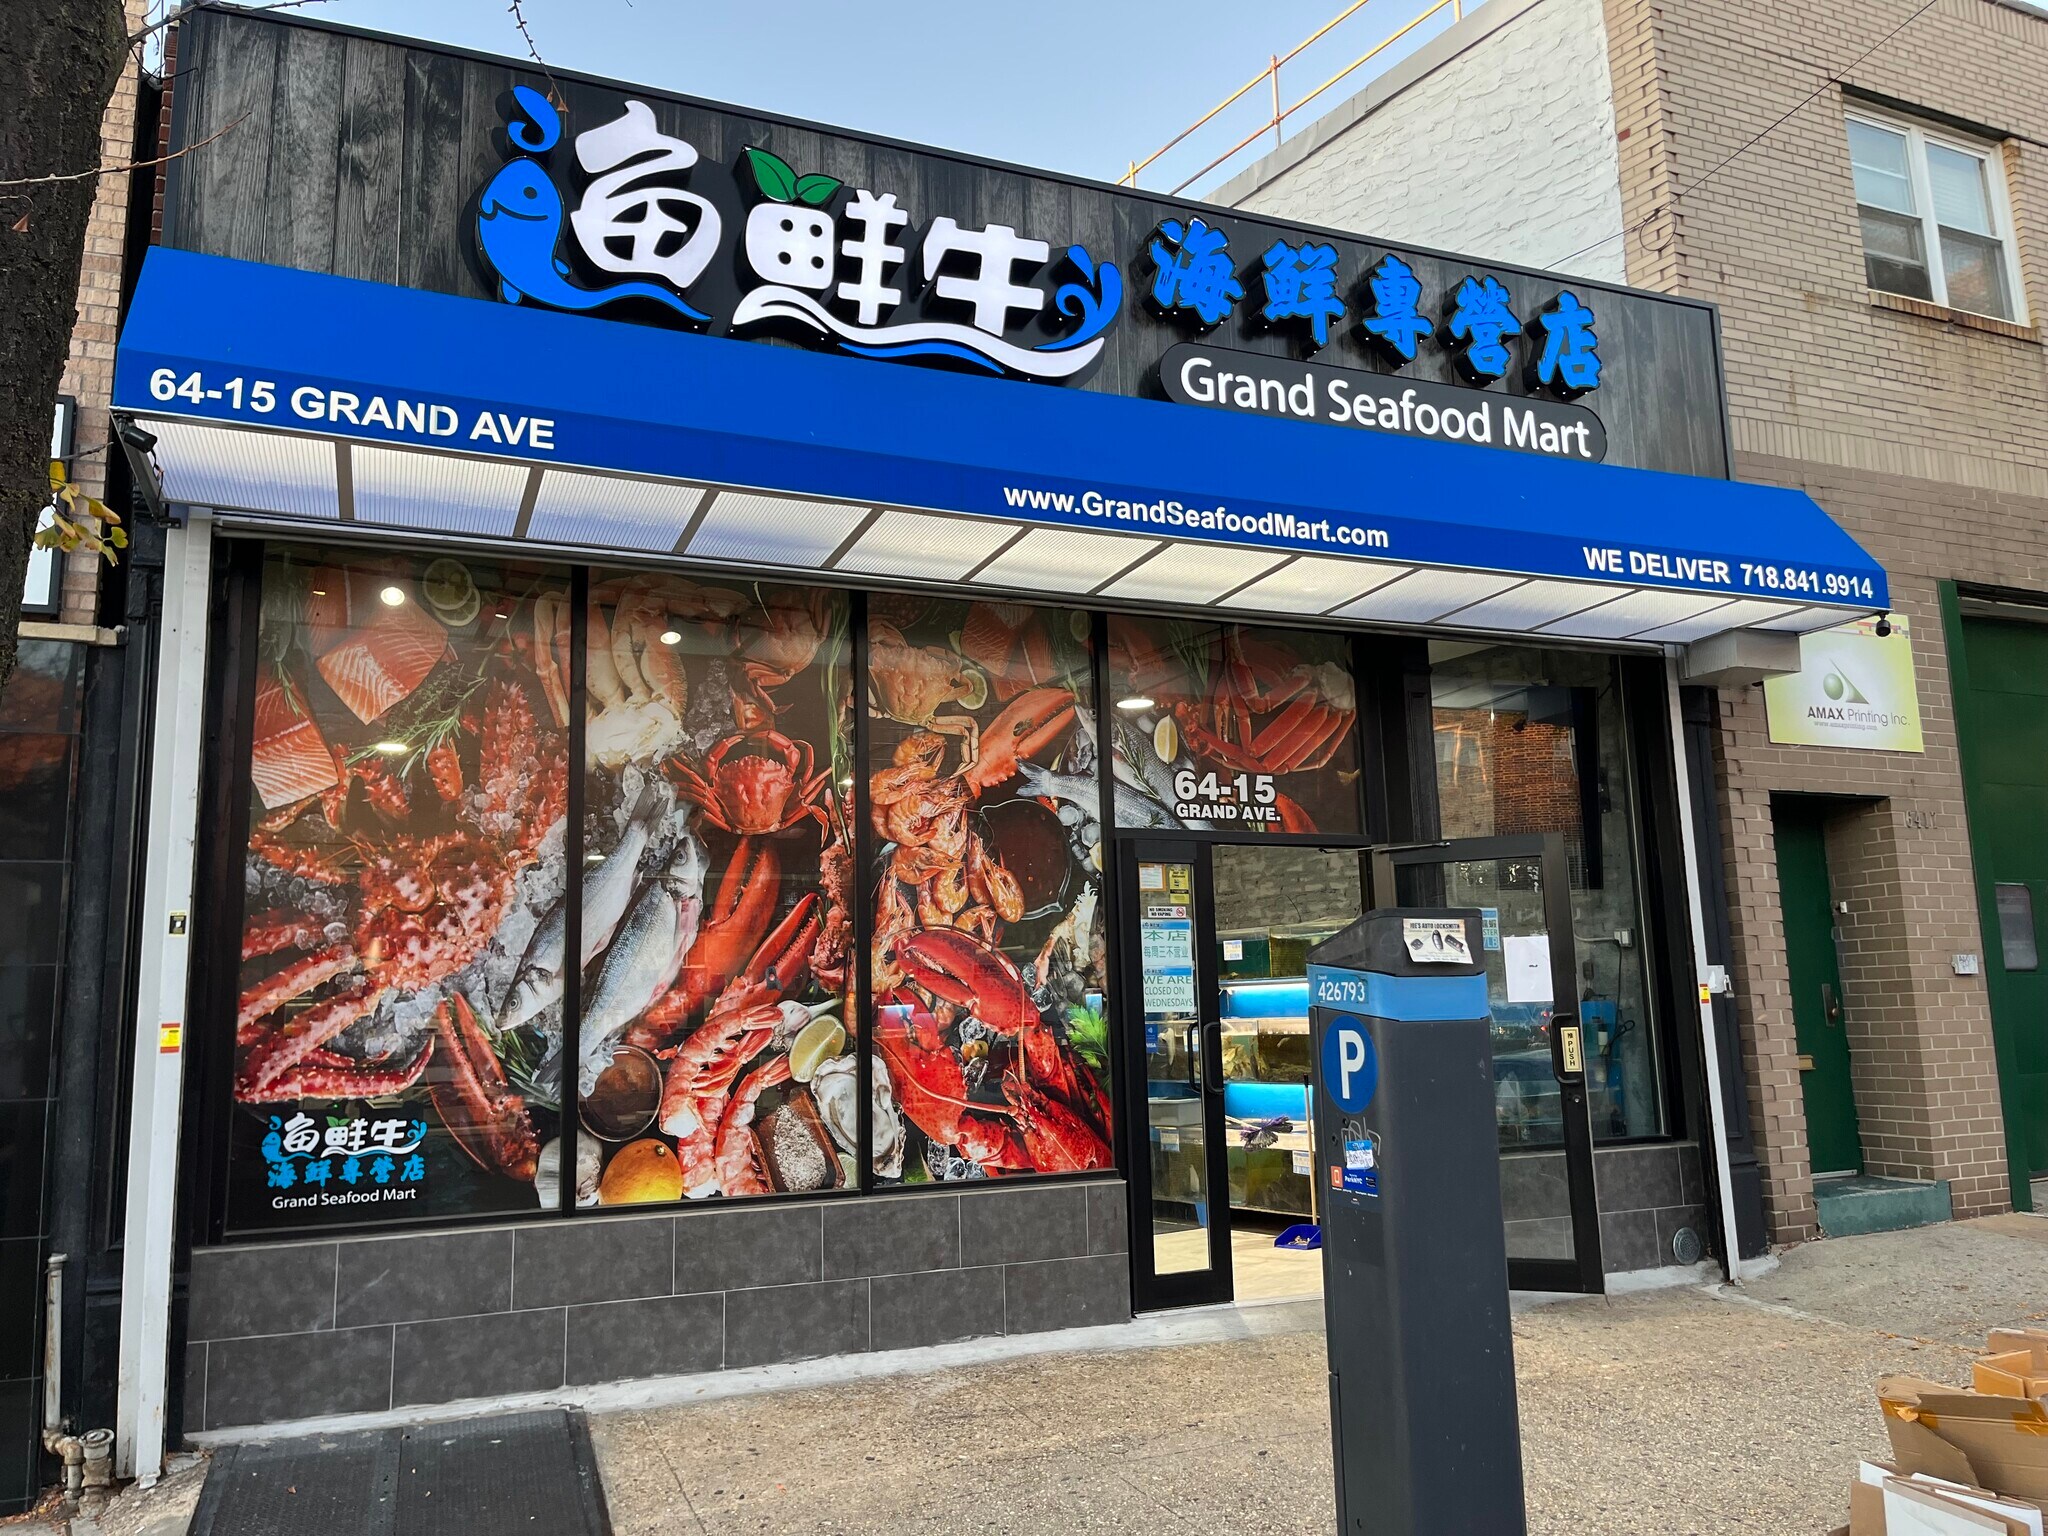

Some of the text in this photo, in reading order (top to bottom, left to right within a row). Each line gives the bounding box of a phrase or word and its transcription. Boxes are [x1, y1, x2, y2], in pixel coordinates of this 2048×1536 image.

[149, 367, 555, 449] 64-15 GRAND AVE
[1180, 357, 1592, 458] Grand Seafood Mart
[1003, 486, 1389, 548] www.GrandSeafoodMart.com
[1583, 546, 1874, 599] WE DELIVER 718.841.9914
[1807, 706, 1911, 727] AMAX Printing Inc.
[1174, 770, 1276, 804] 64-15
[1176, 804, 1281, 821] GRAND AVE.
[1144, 930, 1187, 941] 本店
[1143, 976, 1192, 984] WE ARE
[1145, 987, 1185, 995] CLOSED ON
[1318, 981, 1365, 1001] 426793
[1145, 998, 1193, 1007] WEDNESDAYS
[1567, 1041, 1576, 1066] PUSH
[1338, 1030, 1365, 1099] P
[272, 1188, 416, 1209] Grand Seafood Mart
